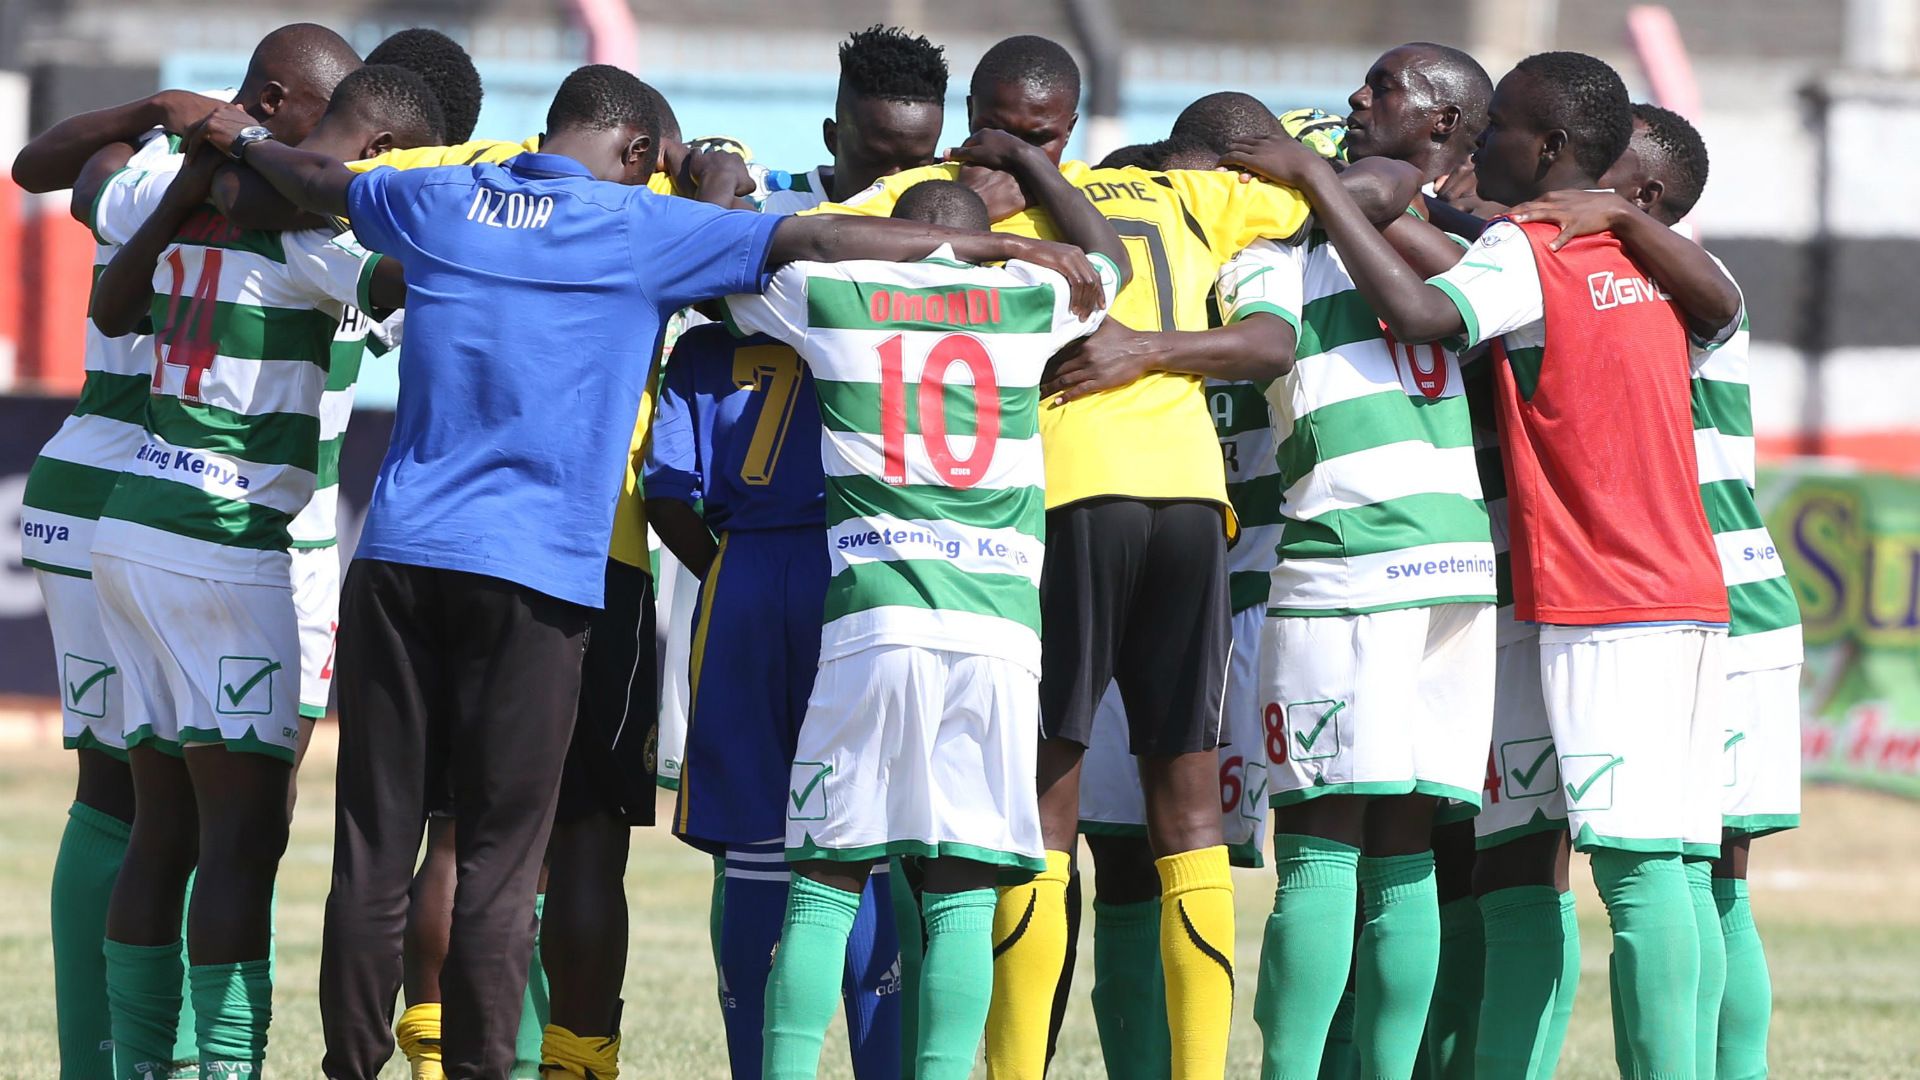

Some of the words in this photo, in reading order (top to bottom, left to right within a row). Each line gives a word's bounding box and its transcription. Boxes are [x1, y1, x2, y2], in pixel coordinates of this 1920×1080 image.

[466, 186, 554, 229] NZOIA
[151, 247, 223, 401] 14
[732, 344, 804, 486] 7
[874, 332, 1000, 489] 10
[174, 450, 250, 490] Kenya
[22, 522, 70, 544] enya
[1386, 555, 1494, 579] sweetening
